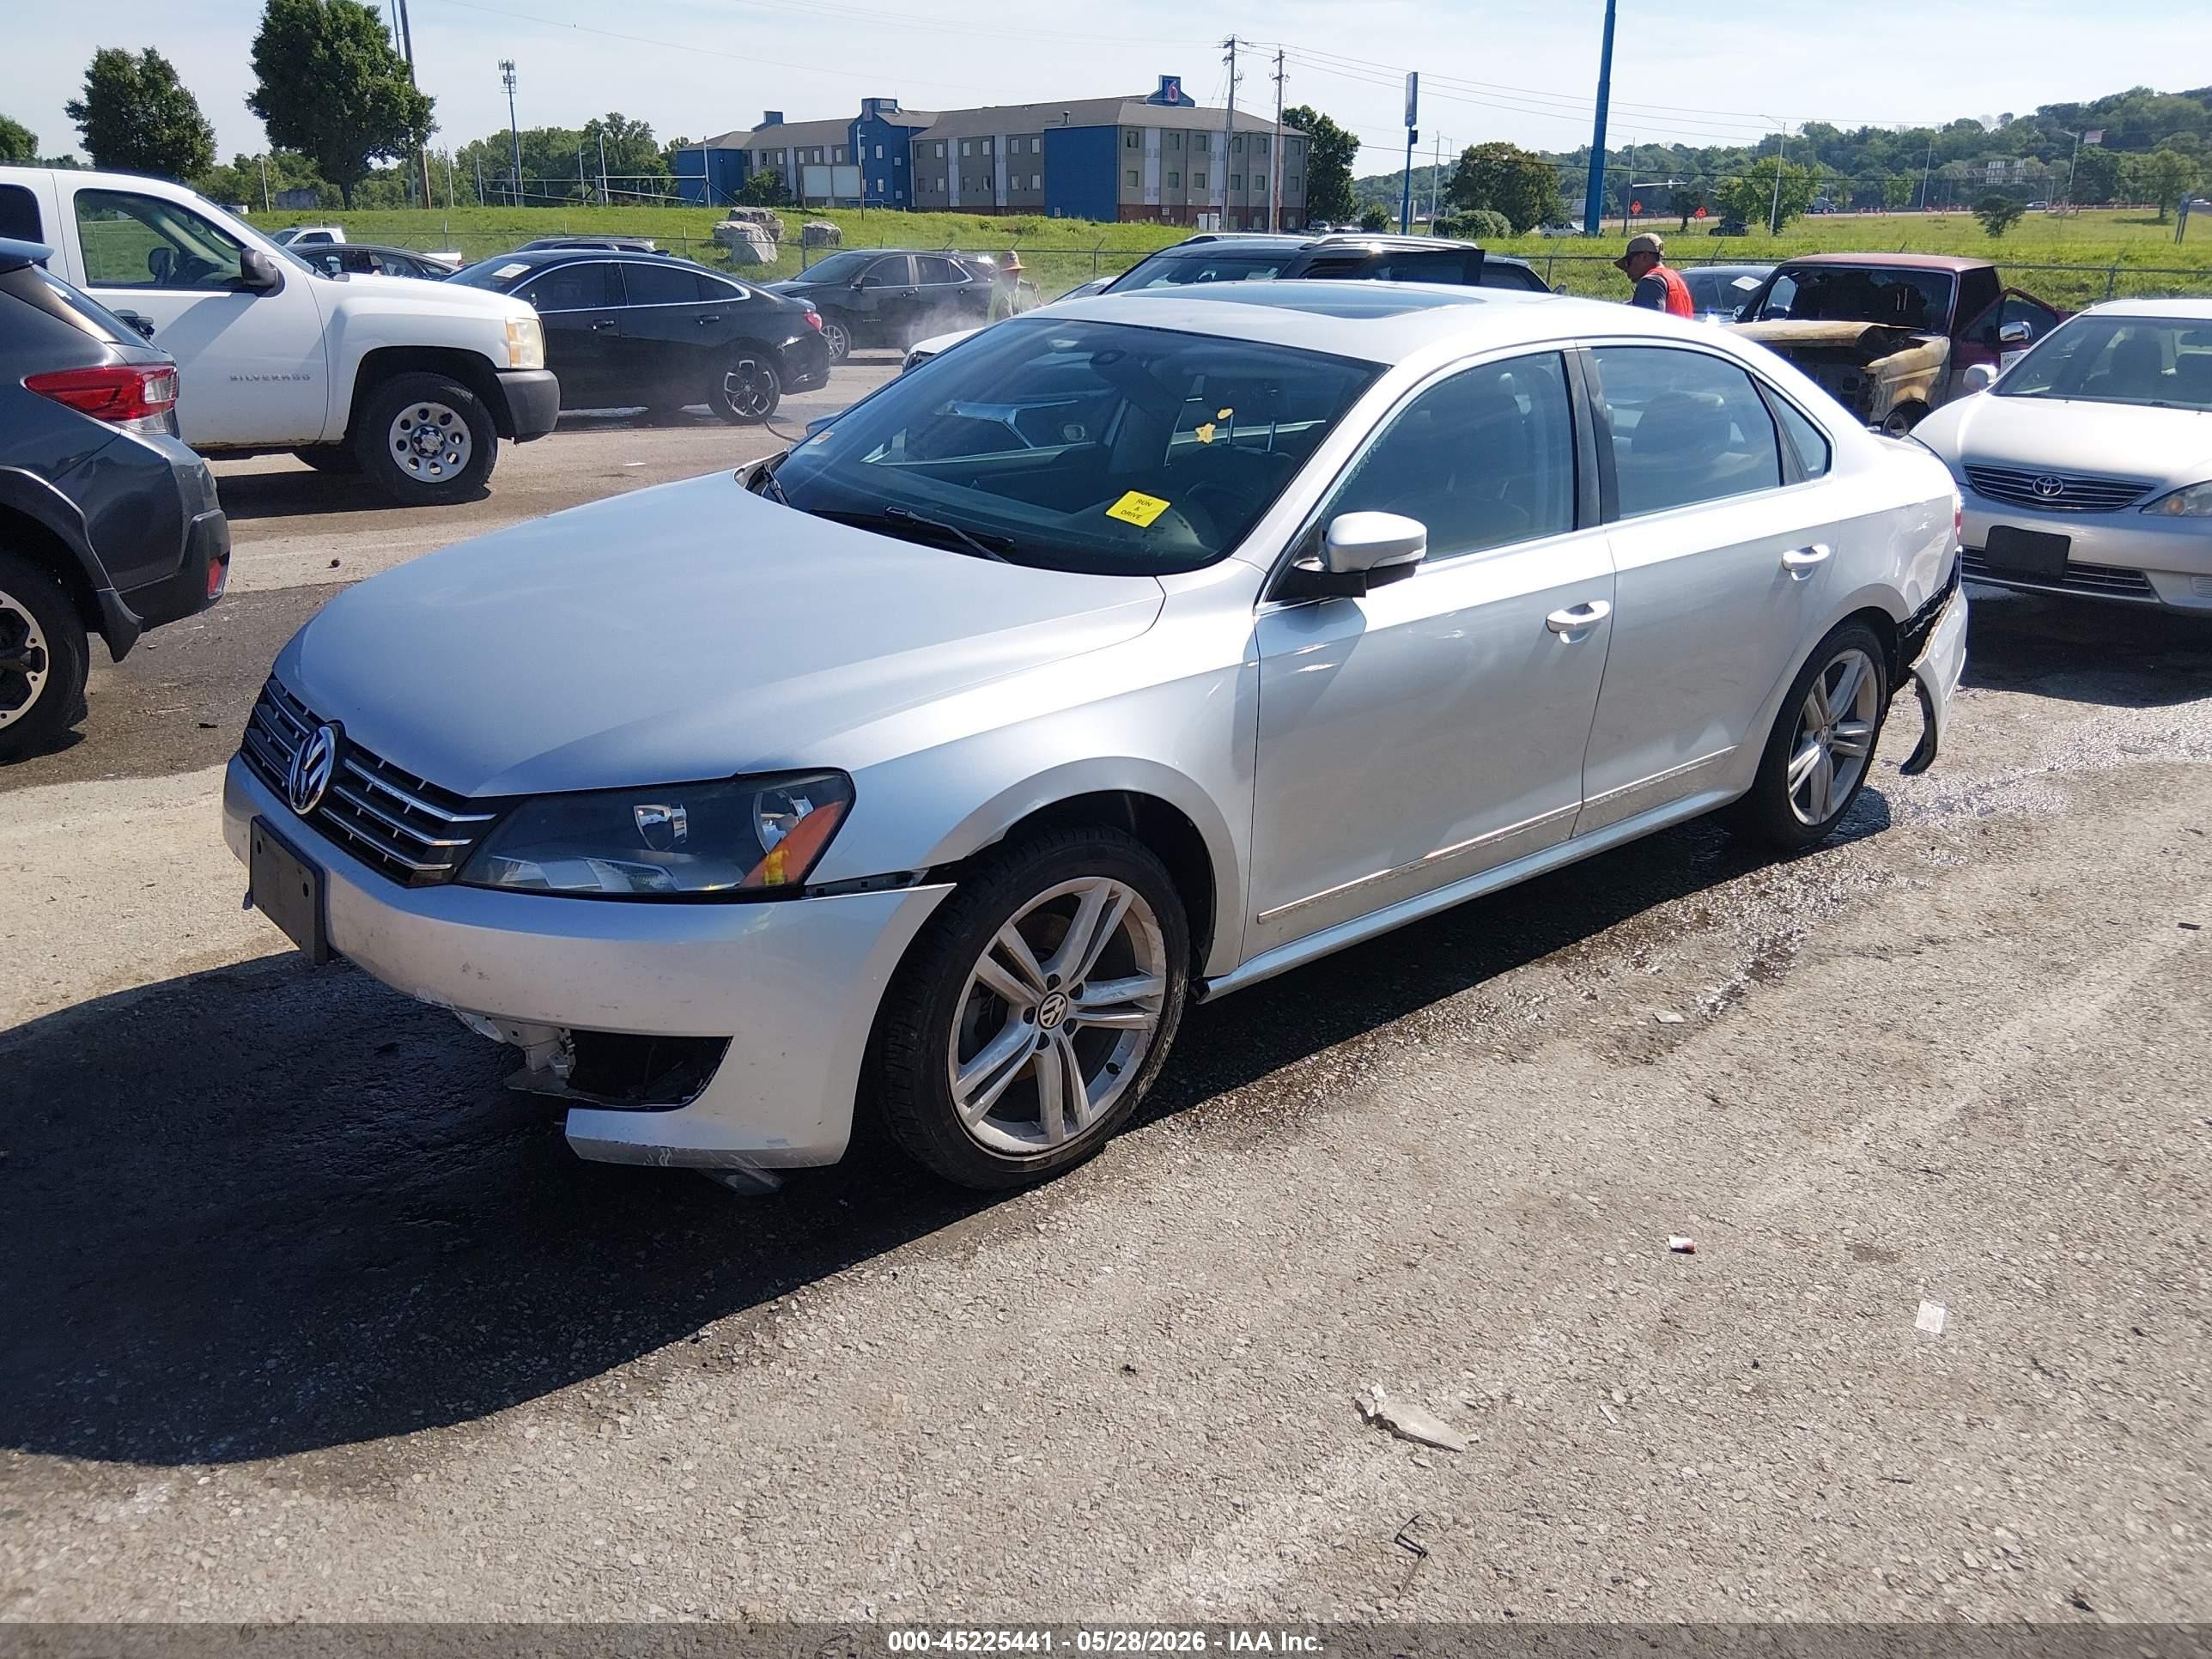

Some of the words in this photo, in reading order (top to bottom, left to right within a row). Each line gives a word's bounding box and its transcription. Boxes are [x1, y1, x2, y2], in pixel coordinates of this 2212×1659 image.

[1167, 80, 1179, 104] 6
[229, 373, 312, 382] SILVERADO
[1135, 498, 1154, 507] RUN
[1120, 509, 1143, 520] DRIVE
